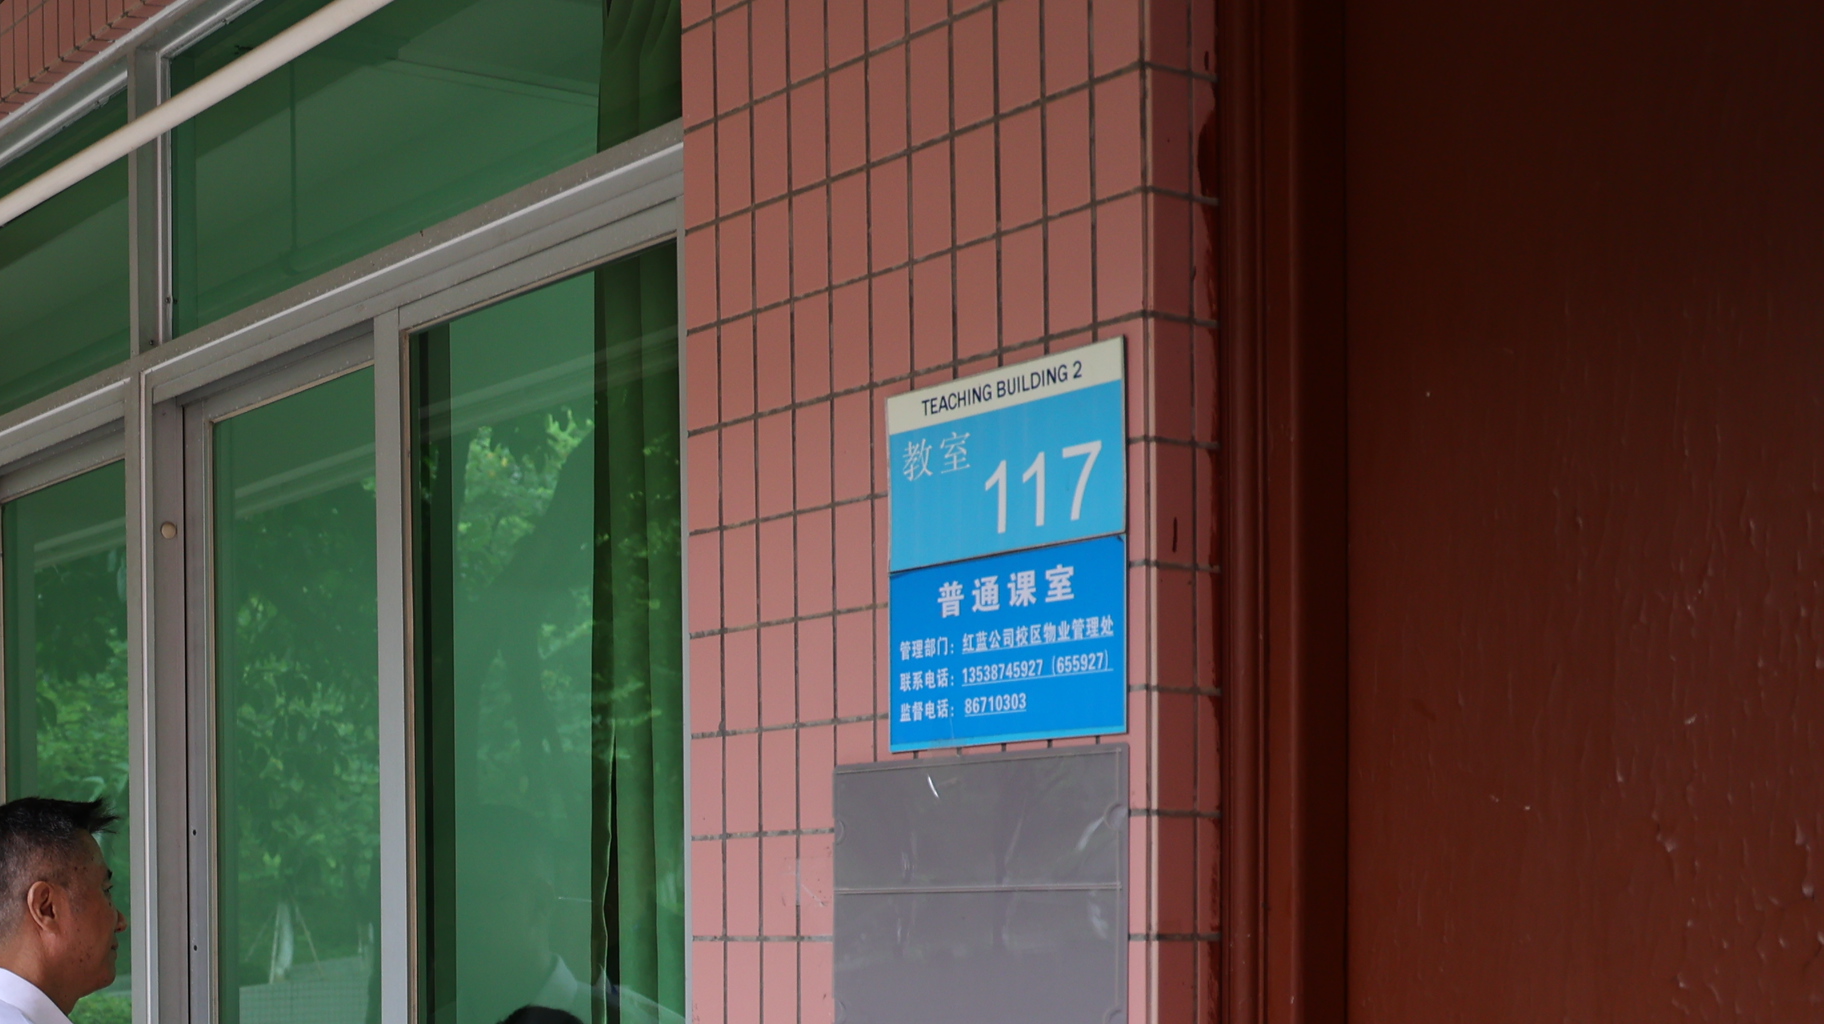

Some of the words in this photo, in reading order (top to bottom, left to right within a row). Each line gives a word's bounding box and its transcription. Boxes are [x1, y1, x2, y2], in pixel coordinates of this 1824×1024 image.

[921, 383, 993, 416] TEACHING
[996, 364, 1068, 398] BUILDING
[1072, 360, 1083, 379] 2
[902, 431, 971, 482] 教室
[984, 440, 1103, 534] 117
[937, 564, 1075, 618] 普通课室
[964, 692, 1027, 714] 86710303
